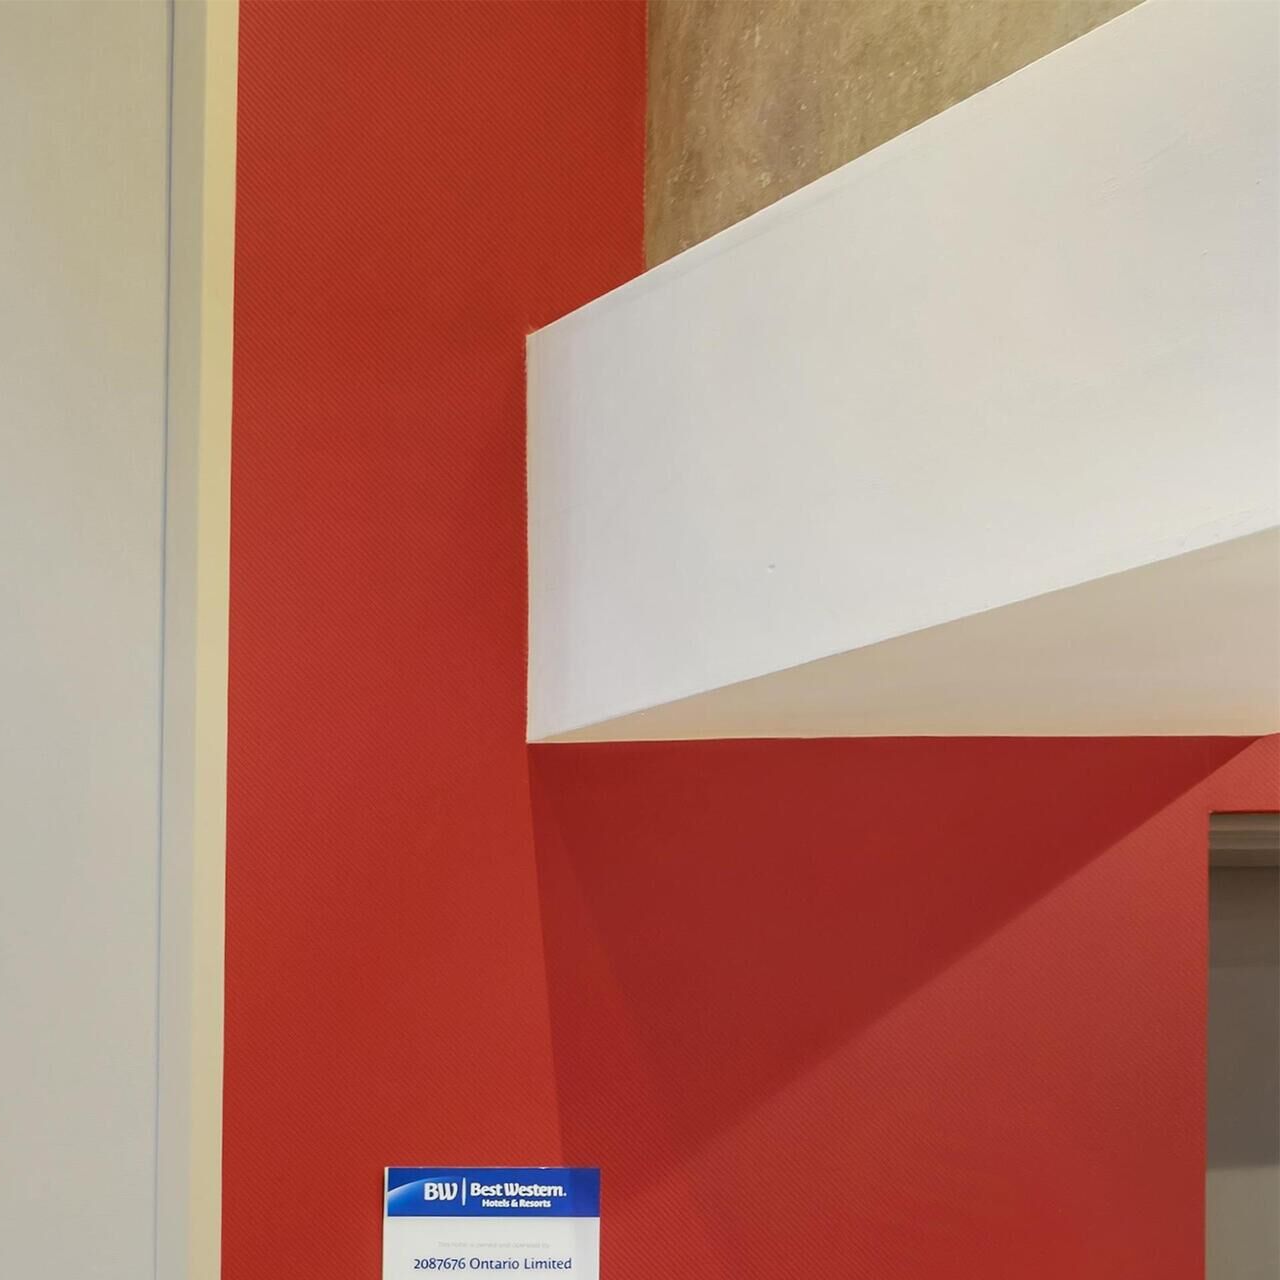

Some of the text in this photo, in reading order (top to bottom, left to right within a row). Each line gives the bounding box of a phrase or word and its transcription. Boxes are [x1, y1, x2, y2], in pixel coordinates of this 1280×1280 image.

[423, 1182, 458, 1201] BW
[470, 1182, 503, 1197] Best
[481, 1199, 510, 1208] Hotels
[519, 1199, 552, 1208] Resorts
[413, 1257, 572, 1270] 2087676 Ontario Limited
